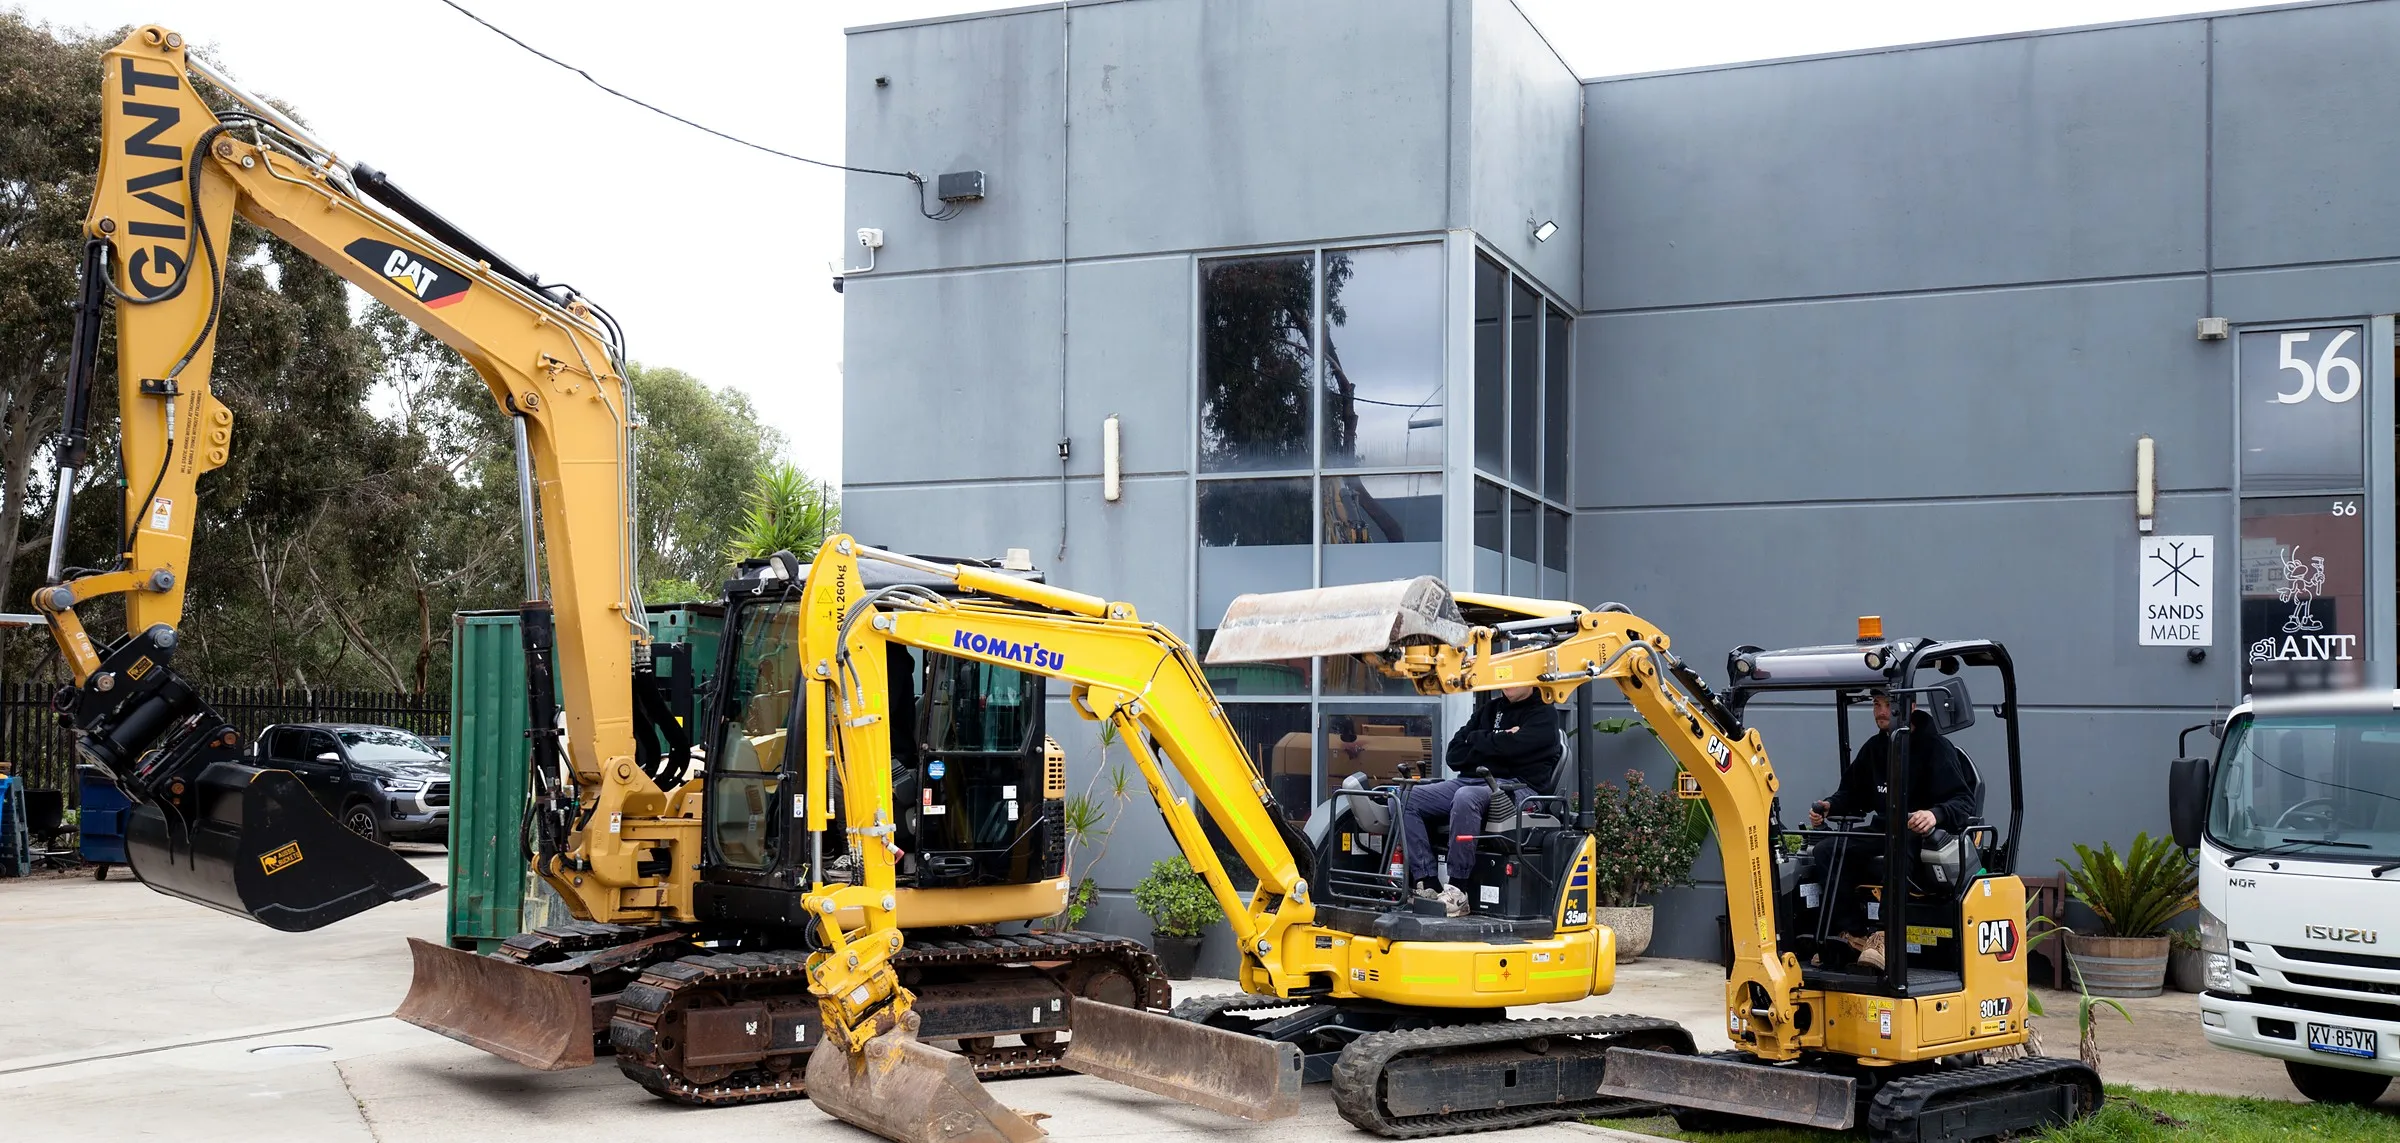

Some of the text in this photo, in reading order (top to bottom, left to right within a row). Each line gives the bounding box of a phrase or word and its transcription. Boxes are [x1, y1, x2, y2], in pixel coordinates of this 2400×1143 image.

[121, 57, 187, 301] GIANT
[384, 249, 438, 298] CAT
[2278, 329, 2361, 404] 56
[2332, 501, 2357, 516] 56
[836, 564, 847, 631] SWL 260kg
[2148, 604, 2204, 619] SANDS
[2151, 624, 2200, 640] MADE
[954, 629, 1065, 671] KOMATSU
[2249, 634, 2356, 664] giANT
[1707, 735, 1730, 766] CAT
[1567, 899, 1578, 910] PC
[1978, 920, 2009, 954] CAT
[2305, 924, 2377, 944] ISUZU
[1980, 998, 2007, 1018] 301.7
